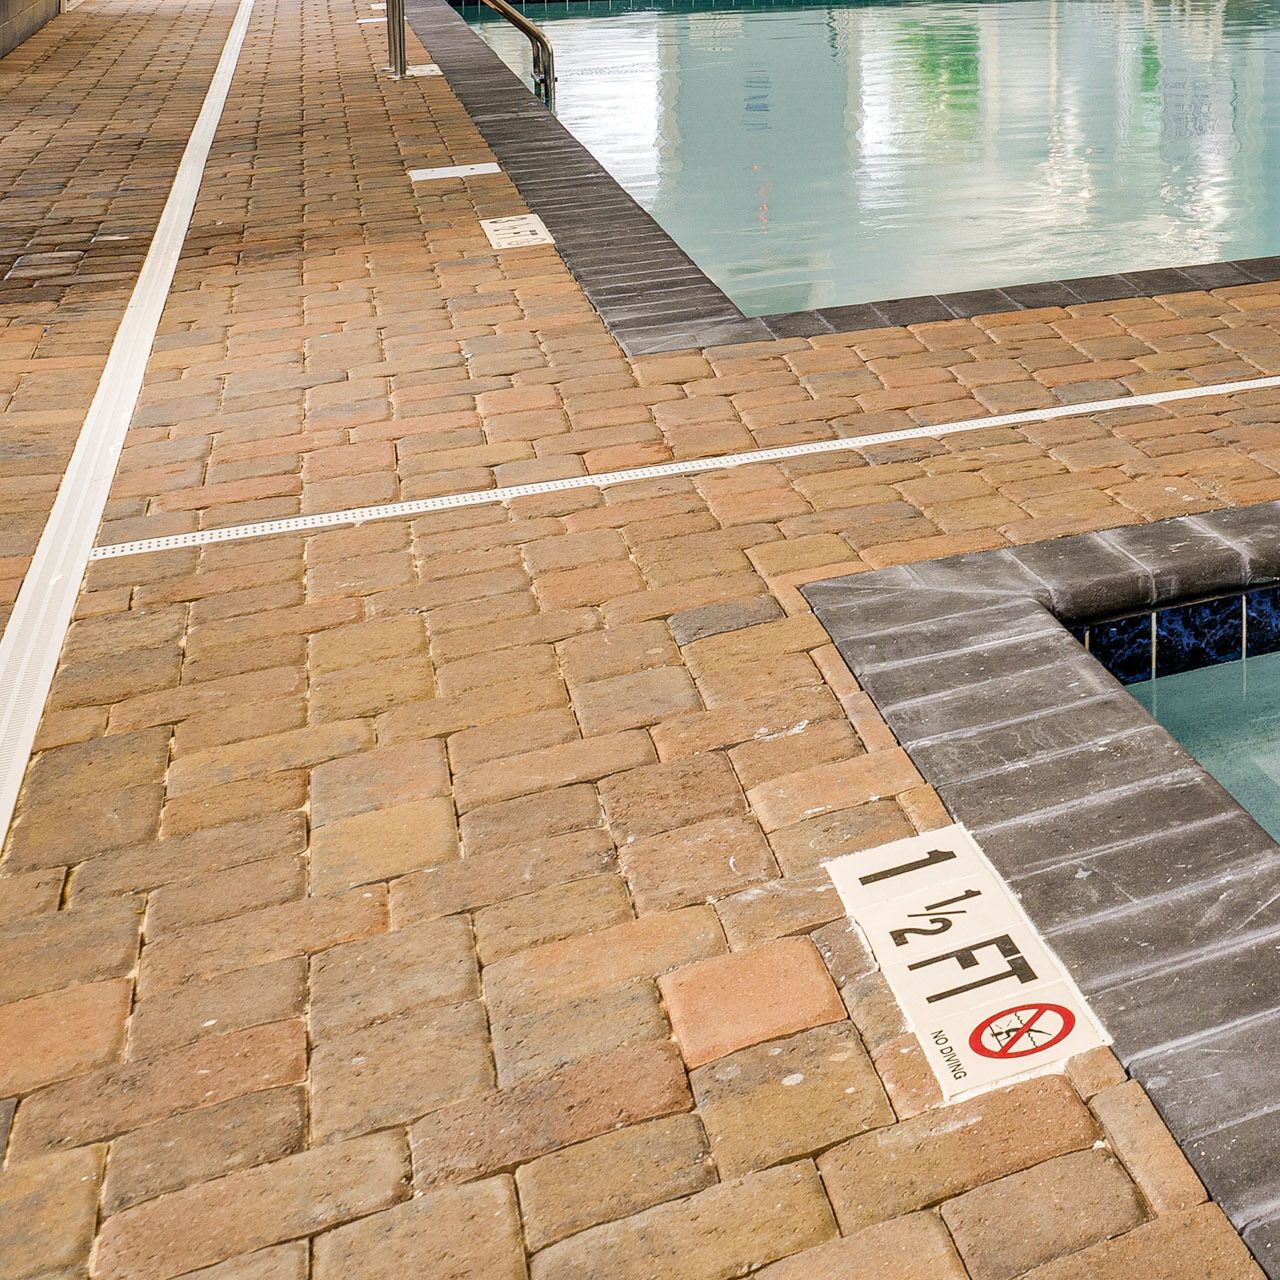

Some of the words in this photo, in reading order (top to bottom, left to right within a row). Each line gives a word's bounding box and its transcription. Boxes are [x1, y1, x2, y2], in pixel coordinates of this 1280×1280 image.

[858, 849, 957, 886] 1
[907, 933, 1039, 1004] FT
[930, 1029, 949, 1047] NO
[939, 1046, 968, 1081] DIVING
